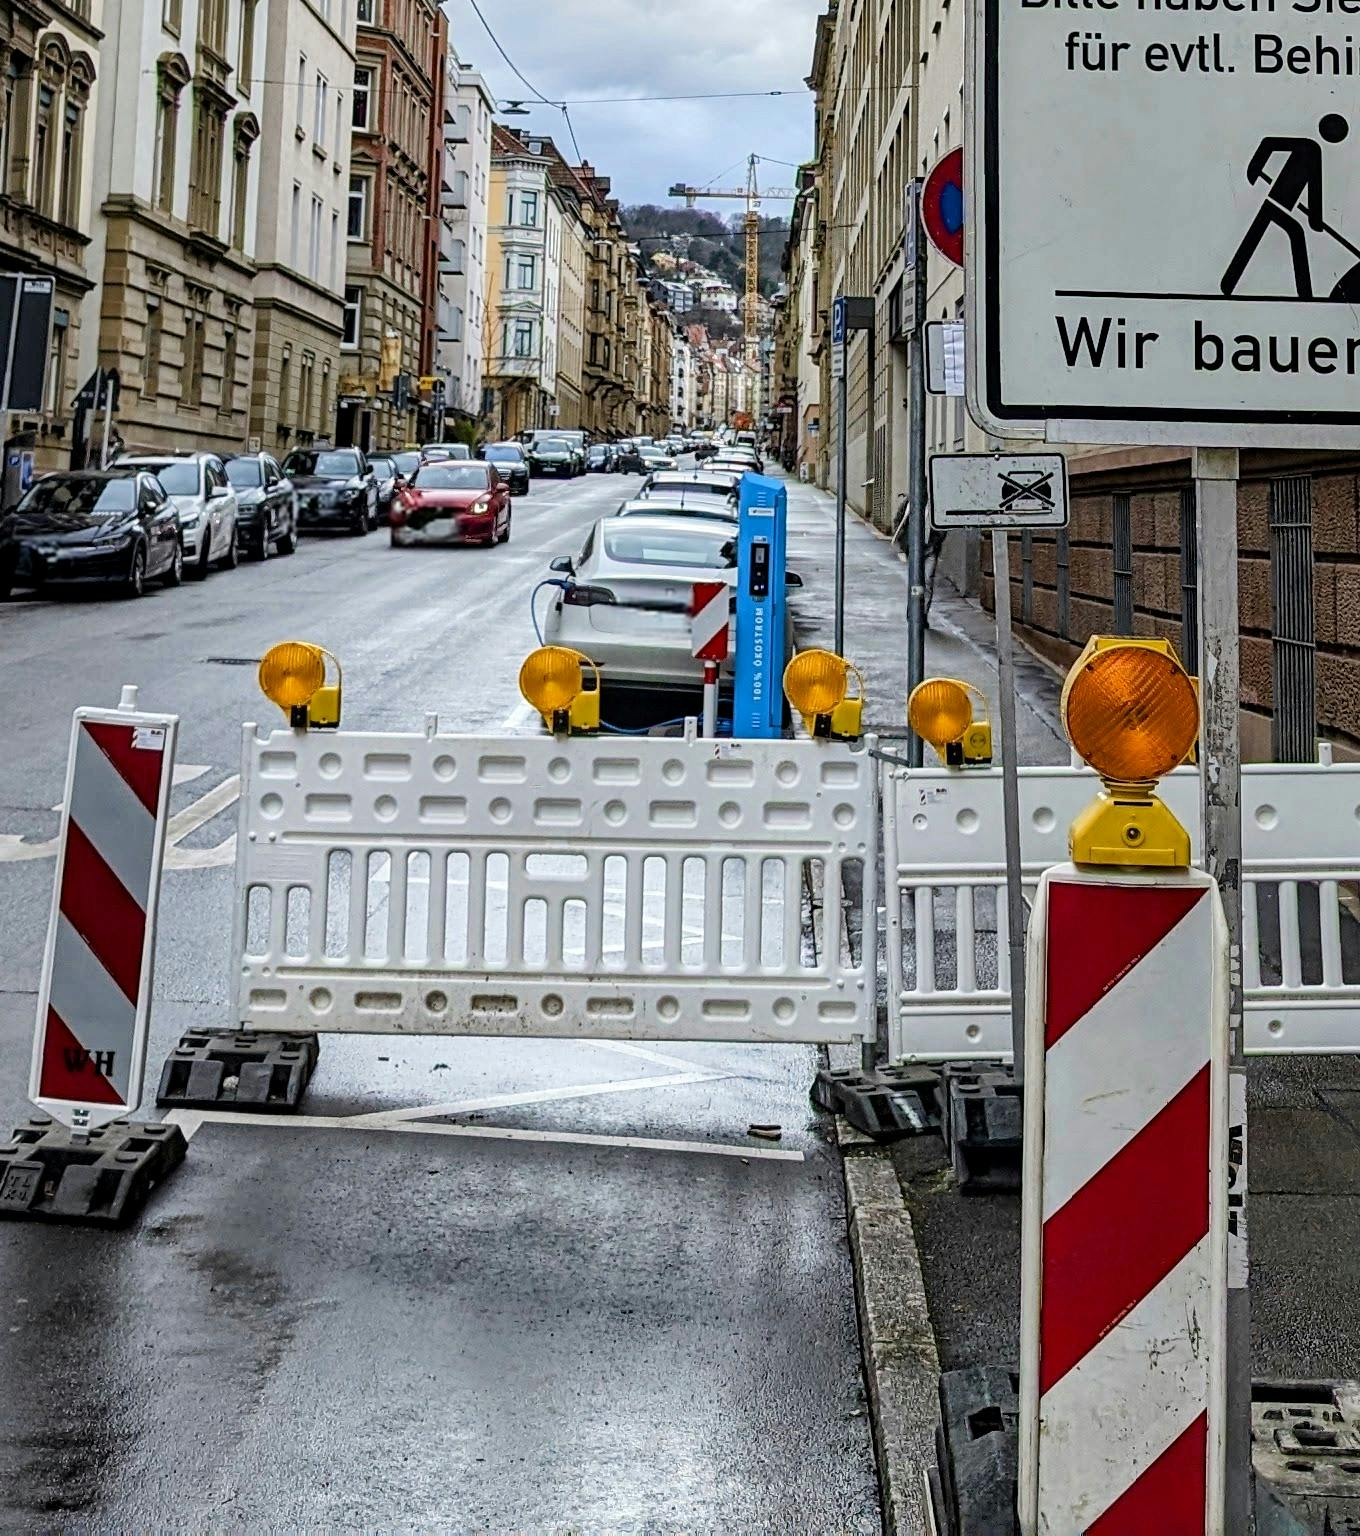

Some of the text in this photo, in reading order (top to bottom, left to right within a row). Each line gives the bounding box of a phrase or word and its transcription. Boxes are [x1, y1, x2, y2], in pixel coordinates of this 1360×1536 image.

[1064, 31, 1131, 72] für
[1145, 32, 1235, 73] evtl.
[1055, 315, 1160, 369] Wir
[64, 1050, 116, 1077] WH
